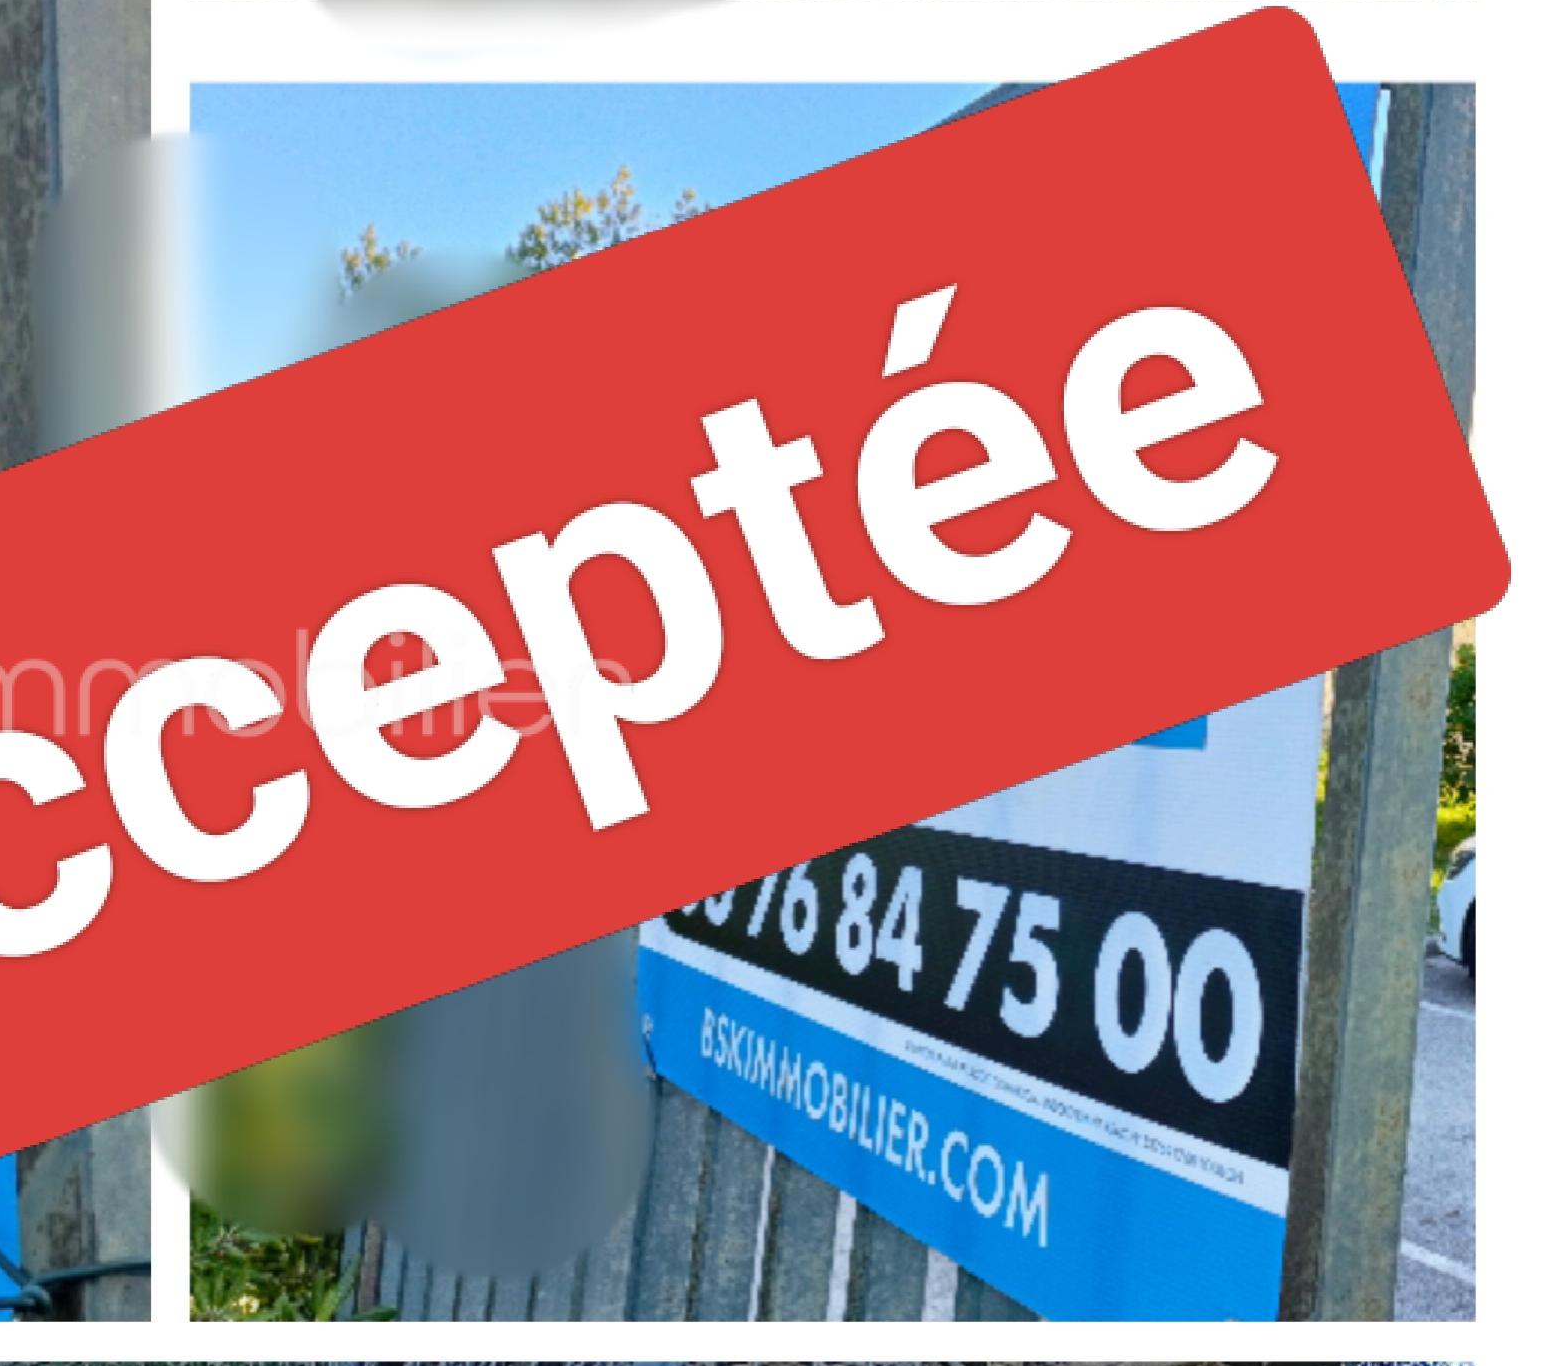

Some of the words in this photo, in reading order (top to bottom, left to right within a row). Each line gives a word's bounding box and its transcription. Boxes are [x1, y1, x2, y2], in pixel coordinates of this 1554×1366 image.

[835, 852, 923, 993] 84
[944, 875, 1060, 1038] 75
[1094, 911, 1264, 1104] 00
[700, 1007, 1047, 1248] BSKIMMOBILIER.COM
